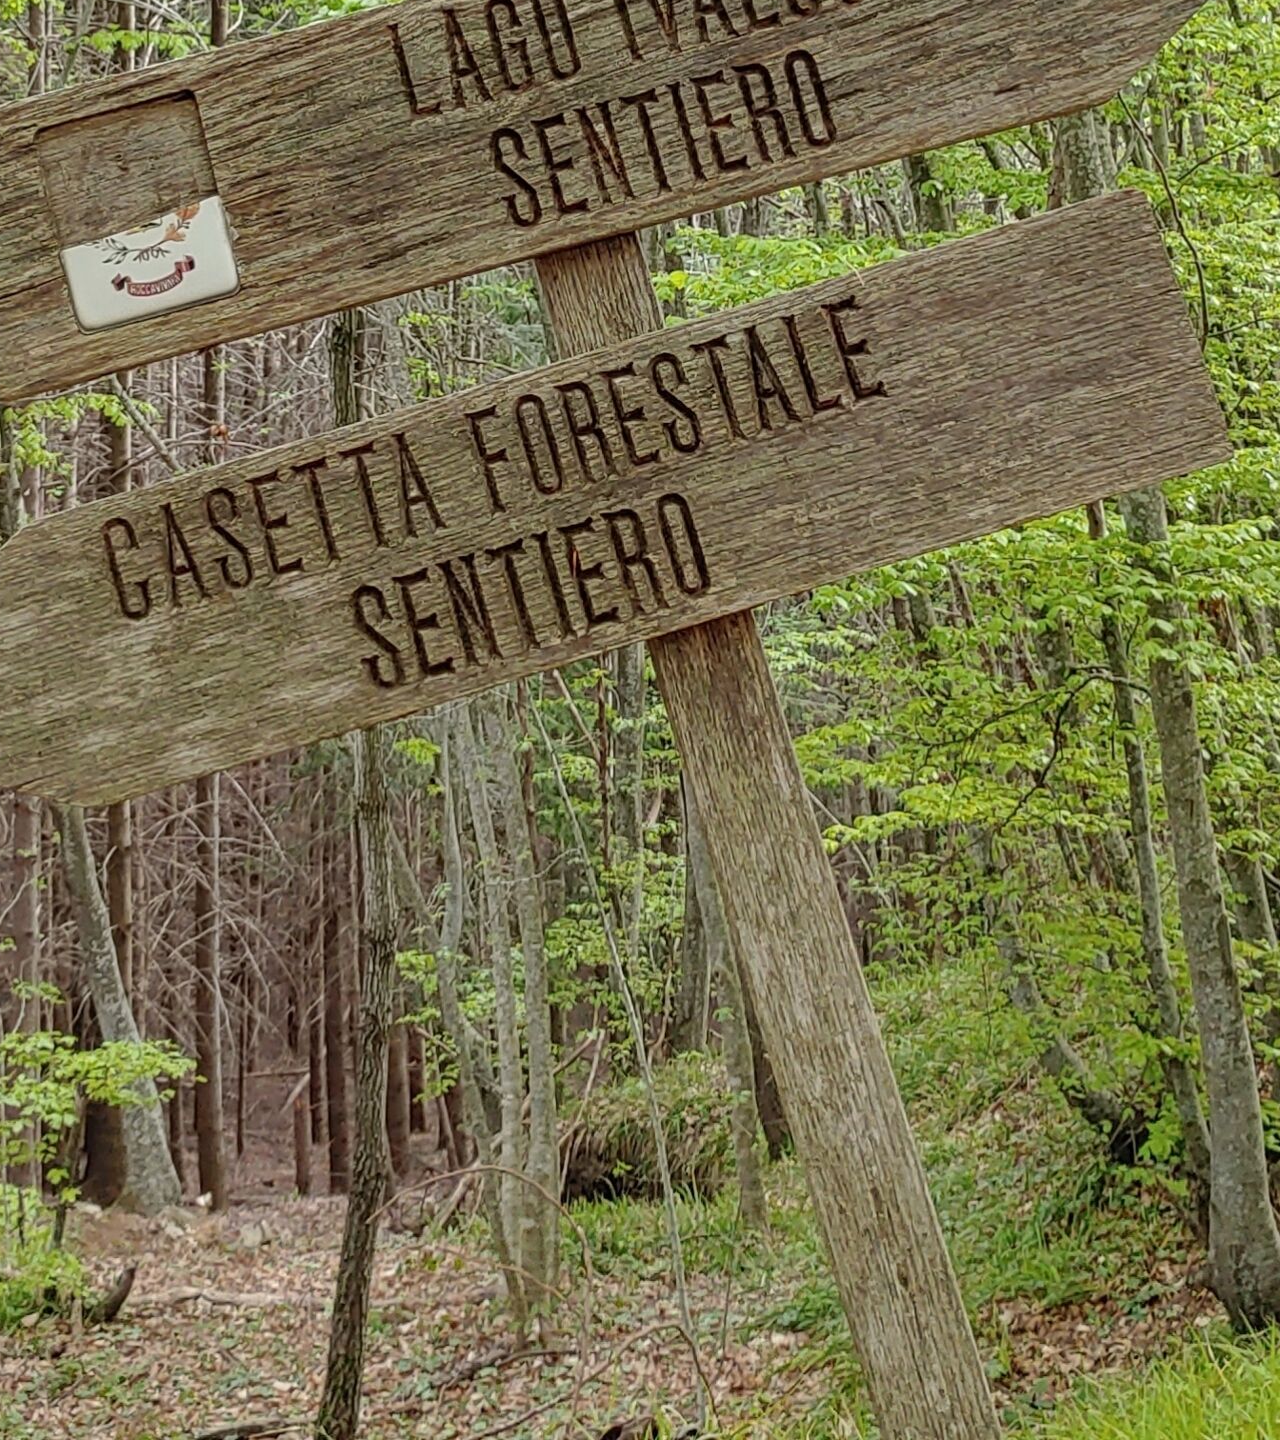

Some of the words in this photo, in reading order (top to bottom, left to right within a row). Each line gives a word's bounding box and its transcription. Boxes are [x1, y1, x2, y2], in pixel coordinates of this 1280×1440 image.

[490, 49, 837, 227] SENTIERO
[102, 433, 447, 620] CASETTA
[465, 297, 888, 512] FORESTALE
[351, 493, 711, 688] SENTIERO
